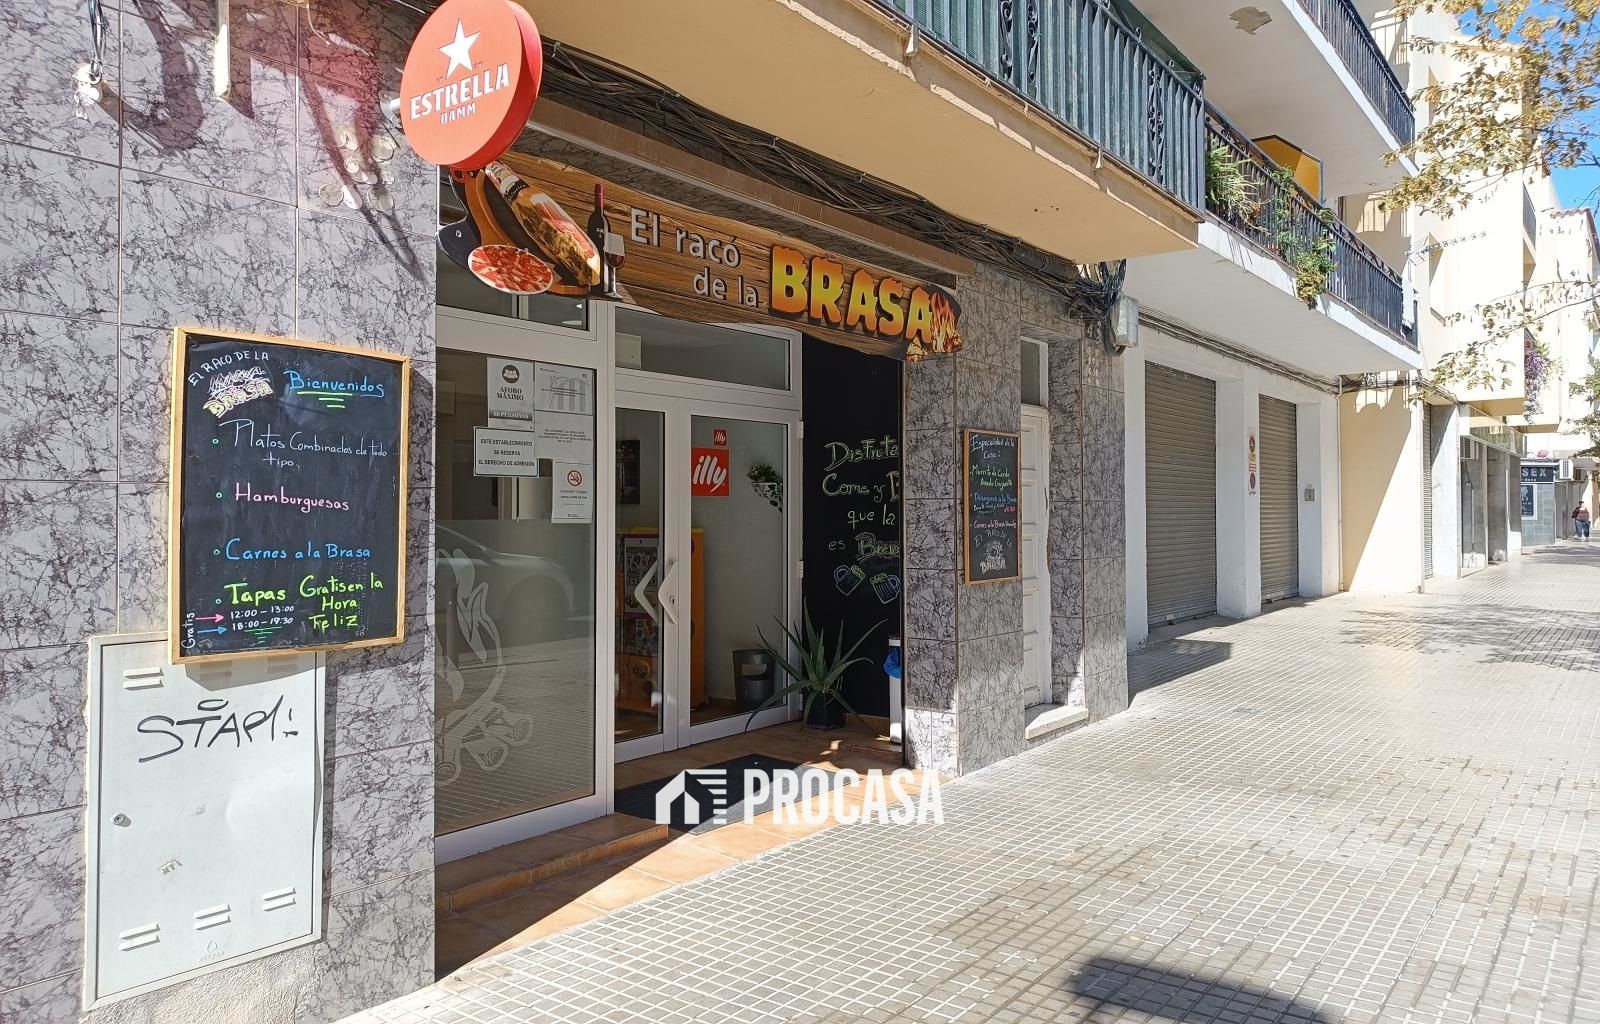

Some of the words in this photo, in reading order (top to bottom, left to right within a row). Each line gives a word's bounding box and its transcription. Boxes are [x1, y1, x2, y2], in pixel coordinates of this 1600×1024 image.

[410, 63, 510, 120] ESTRELLA
[440, 102, 477, 125] DAMM
[630, 207, 661, 248] El
[676, 228, 742, 268] racó
[693, 267, 728, 301] de
[738, 275, 759, 309] la
[770, 245, 935, 344] BRASA
[200, 355, 233, 373] RACO
[233, 350, 251, 361] DE
[254, 350, 270, 361] LA
[283, 370, 385, 398] Bienvenidos
[219, 418, 286, 448] Platos
[289, 431, 352, 455] Combinados
[355, 437, 367, 456] de
[714, 431, 726, 444] illy
[693, 455, 727, 493] illy
[822, 472, 870, 496] Come
[873, 484, 886, 504] y
[235, 483, 350, 513] Hamburguesas
[847, 510, 876, 530] que
[882, 503, 896, 526] la
[225, 538, 287, 560] Carnes
[294, 550, 304, 559] a
[307, 541, 321, 559] la
[324, 544, 372, 559] Brasa
[828, 540, 847, 552] es
[223, 582, 287, 607] Tapas
[370, 571, 384, 589] la
[230, 608, 258, 620] 12:00
[270, 604, 295, 614] 13:00
[321, 596, 358, 612] Hora
[180, 611, 196, 650] Gratis
[308, 613, 359, 633] Feliz
